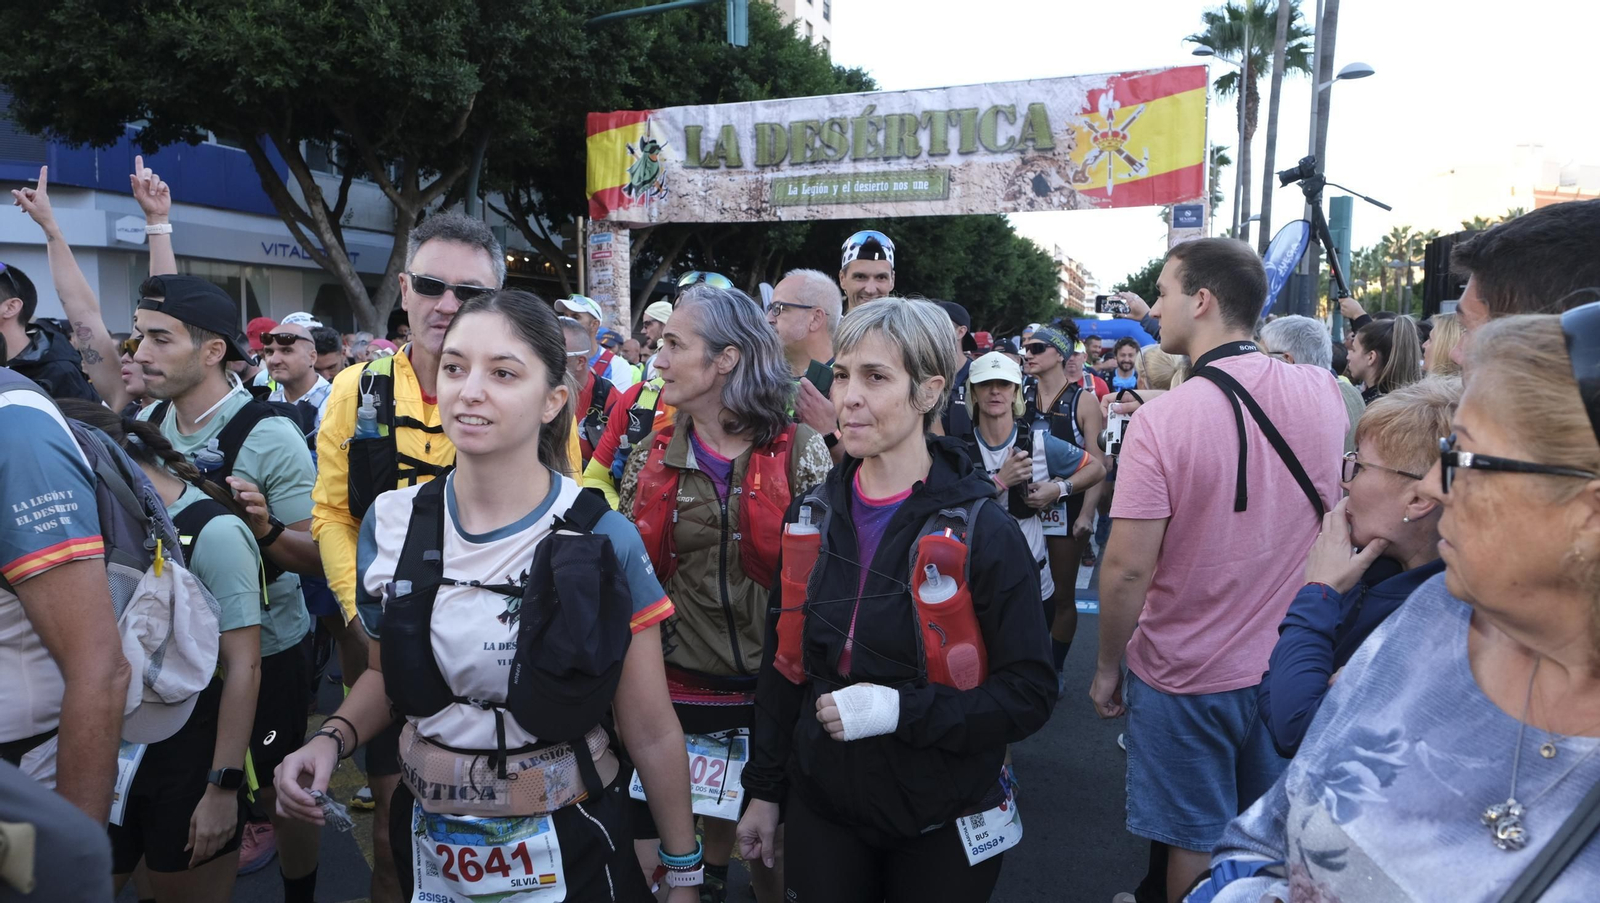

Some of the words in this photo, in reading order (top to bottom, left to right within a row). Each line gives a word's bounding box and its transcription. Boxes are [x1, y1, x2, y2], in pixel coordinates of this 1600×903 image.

[682, 124, 744, 169] LA
[755, 102, 1056, 167] DESÉRTICA
[788, 184, 799, 196] La
[801, 183, 829, 197] Legión
[832, 184, 839, 195] y
[842, 181, 851, 193] el
[854, 180, 889, 193] desierto
[893, 181, 909, 191] nos
[912, 180, 930, 190] une
[261, 242, 360, 265] VITALT
[12, 501, 30, 513] LA
[66, 490, 74, 499] Y
[15, 515, 33, 526] EL
[33, 519, 58, 534] NOS
[483, 642, 495, 650] LA
[690, 755, 725, 788] 02
[709, 787, 726, 796] NIÑS
[974, 830, 989, 841] BUS
[436, 841, 534, 883] 2641
[511, 877, 539, 887] SILVIA
